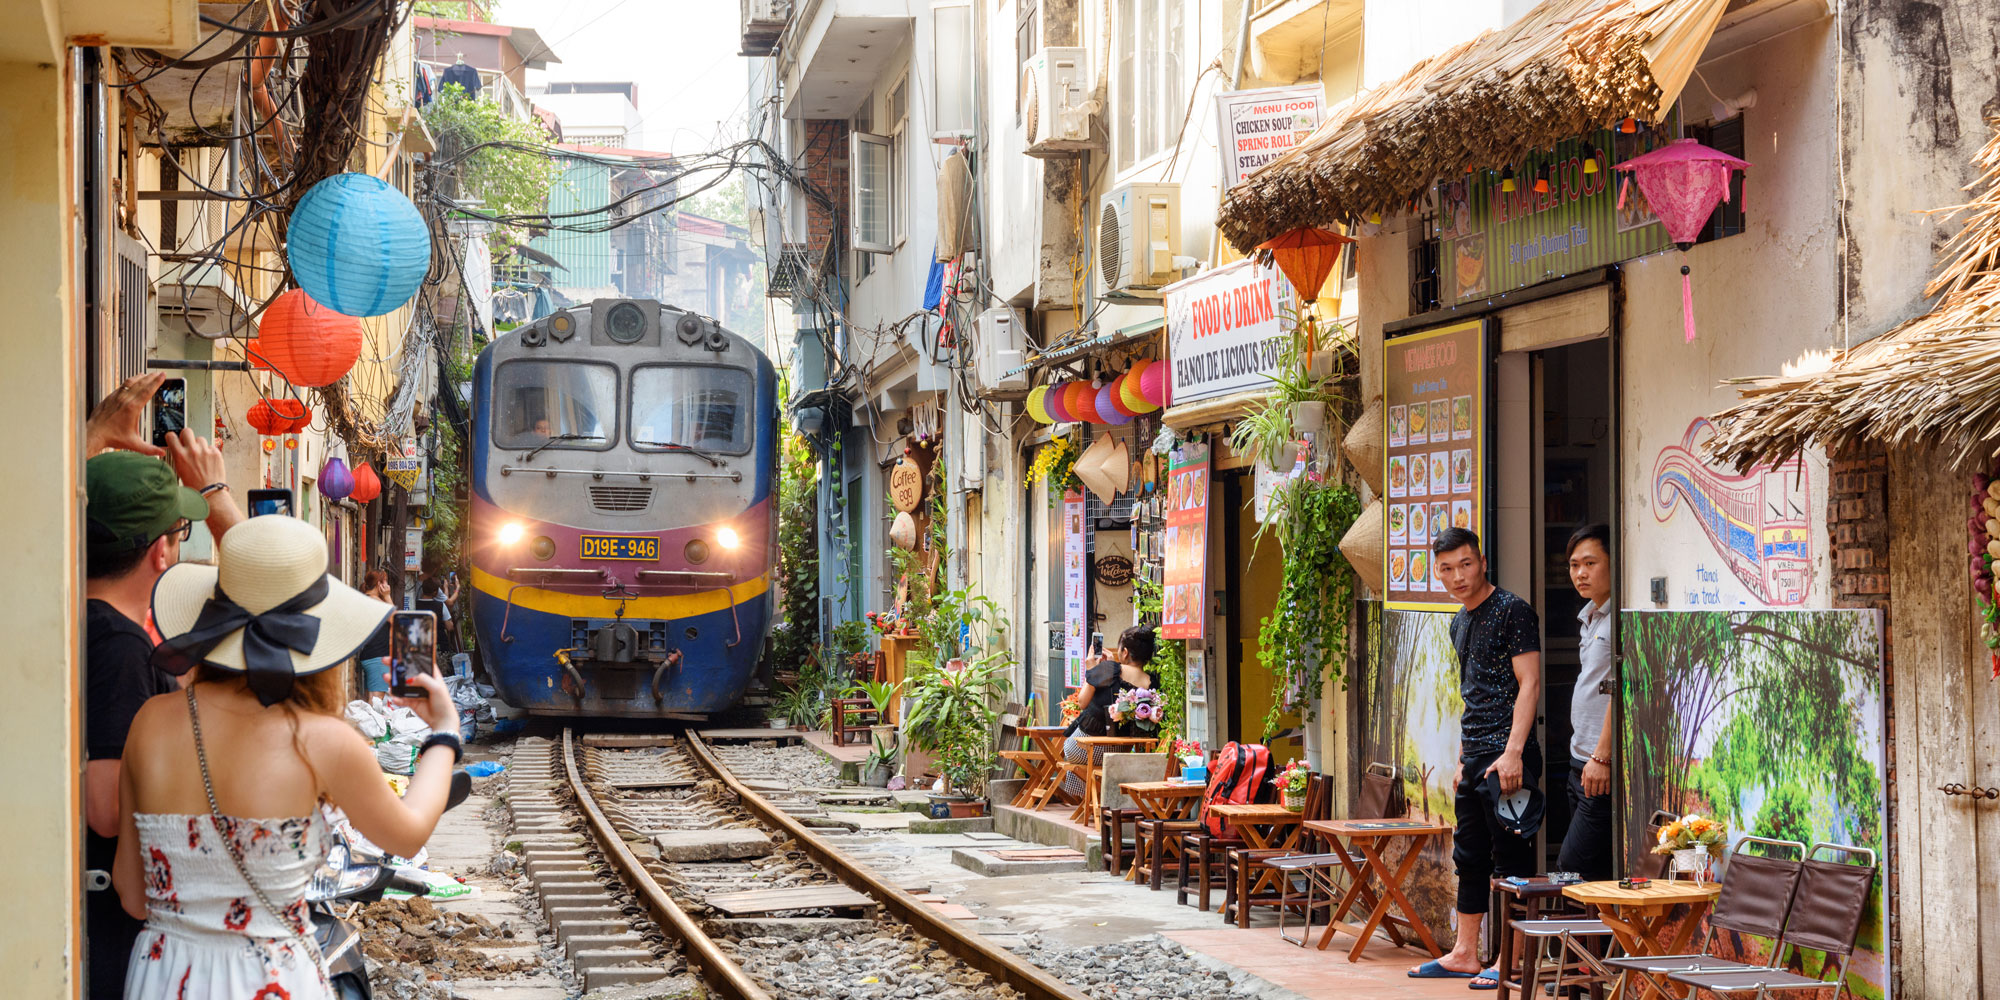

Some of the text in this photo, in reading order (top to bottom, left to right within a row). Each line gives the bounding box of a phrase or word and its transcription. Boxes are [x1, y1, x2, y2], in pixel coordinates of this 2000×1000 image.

[1253, 104, 1282, 115] MENU
[1285, 101, 1315, 112] FOOD
[1236, 117, 1293, 135] CHICKEN SOUP
[1237, 134, 1293, 152] SPRING ROLL
[1239, 154, 1269, 168] STEAM
[1560, 148, 1607, 205] FOOD
[1510, 242, 1521, 265] 30
[1192, 294, 1221, 340] FOOD
[1222, 290, 1232, 332] &
[1233, 278, 1274, 328] DRINK
[1177, 354, 1206, 388] HANOI
[1206, 350, 1220, 381] DE
[1220, 341, 1259, 379] LICIOUS
[892, 471, 917, 489] Coffee
[899, 488, 914, 507] egg
[1096, 563, 1131, 578] Welcome
[1696, 563, 1718, 583] Hanoi
[1702, 585, 1721, 605] track
